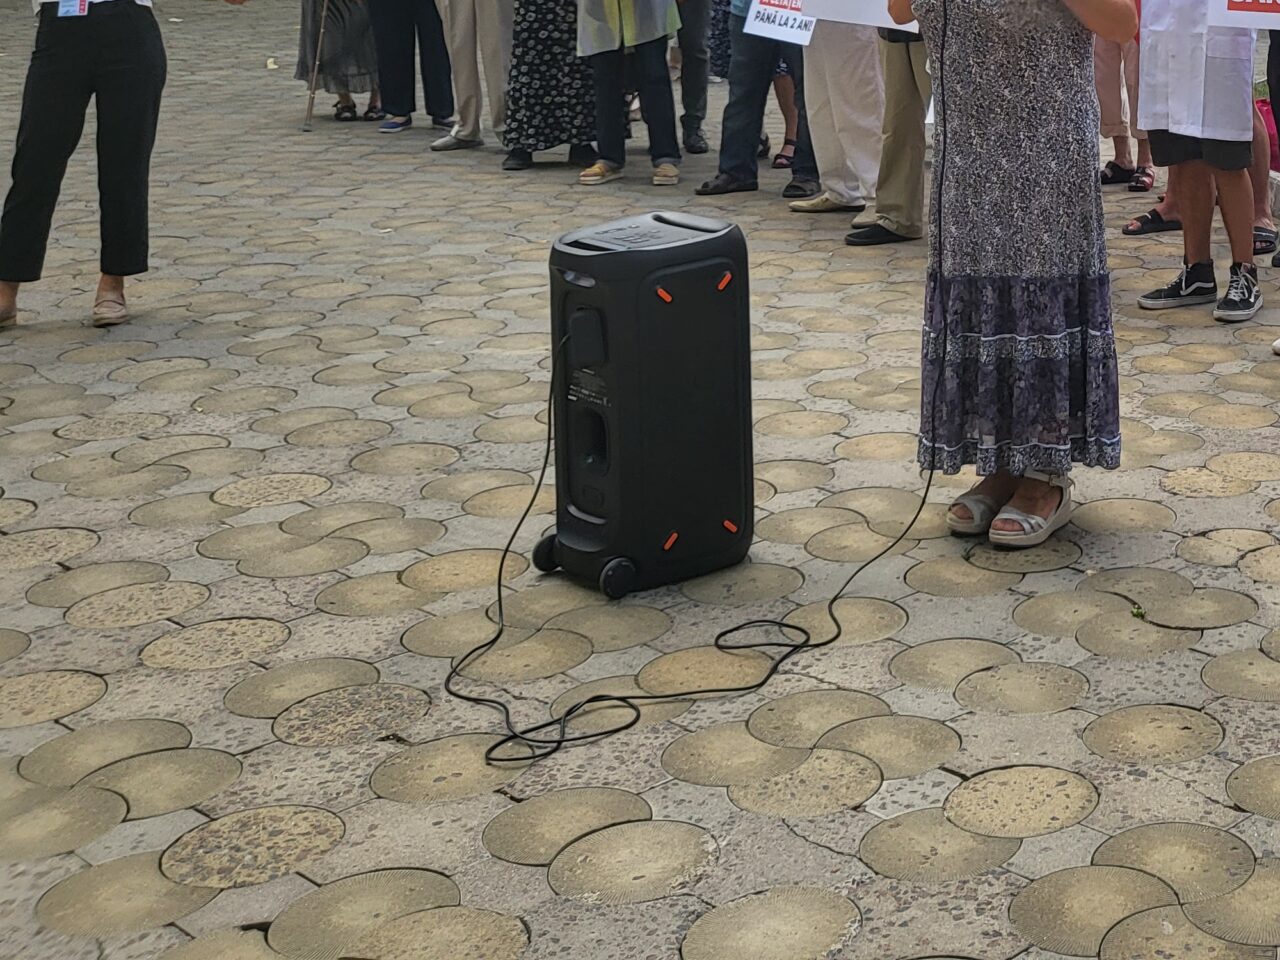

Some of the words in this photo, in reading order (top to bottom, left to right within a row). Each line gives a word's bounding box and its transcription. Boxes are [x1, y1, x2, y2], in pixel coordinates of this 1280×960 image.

[754, 8, 778, 25] PÂNĂ
[778, 15, 789, 28] LA
[790, 17, 797, 29] 2
